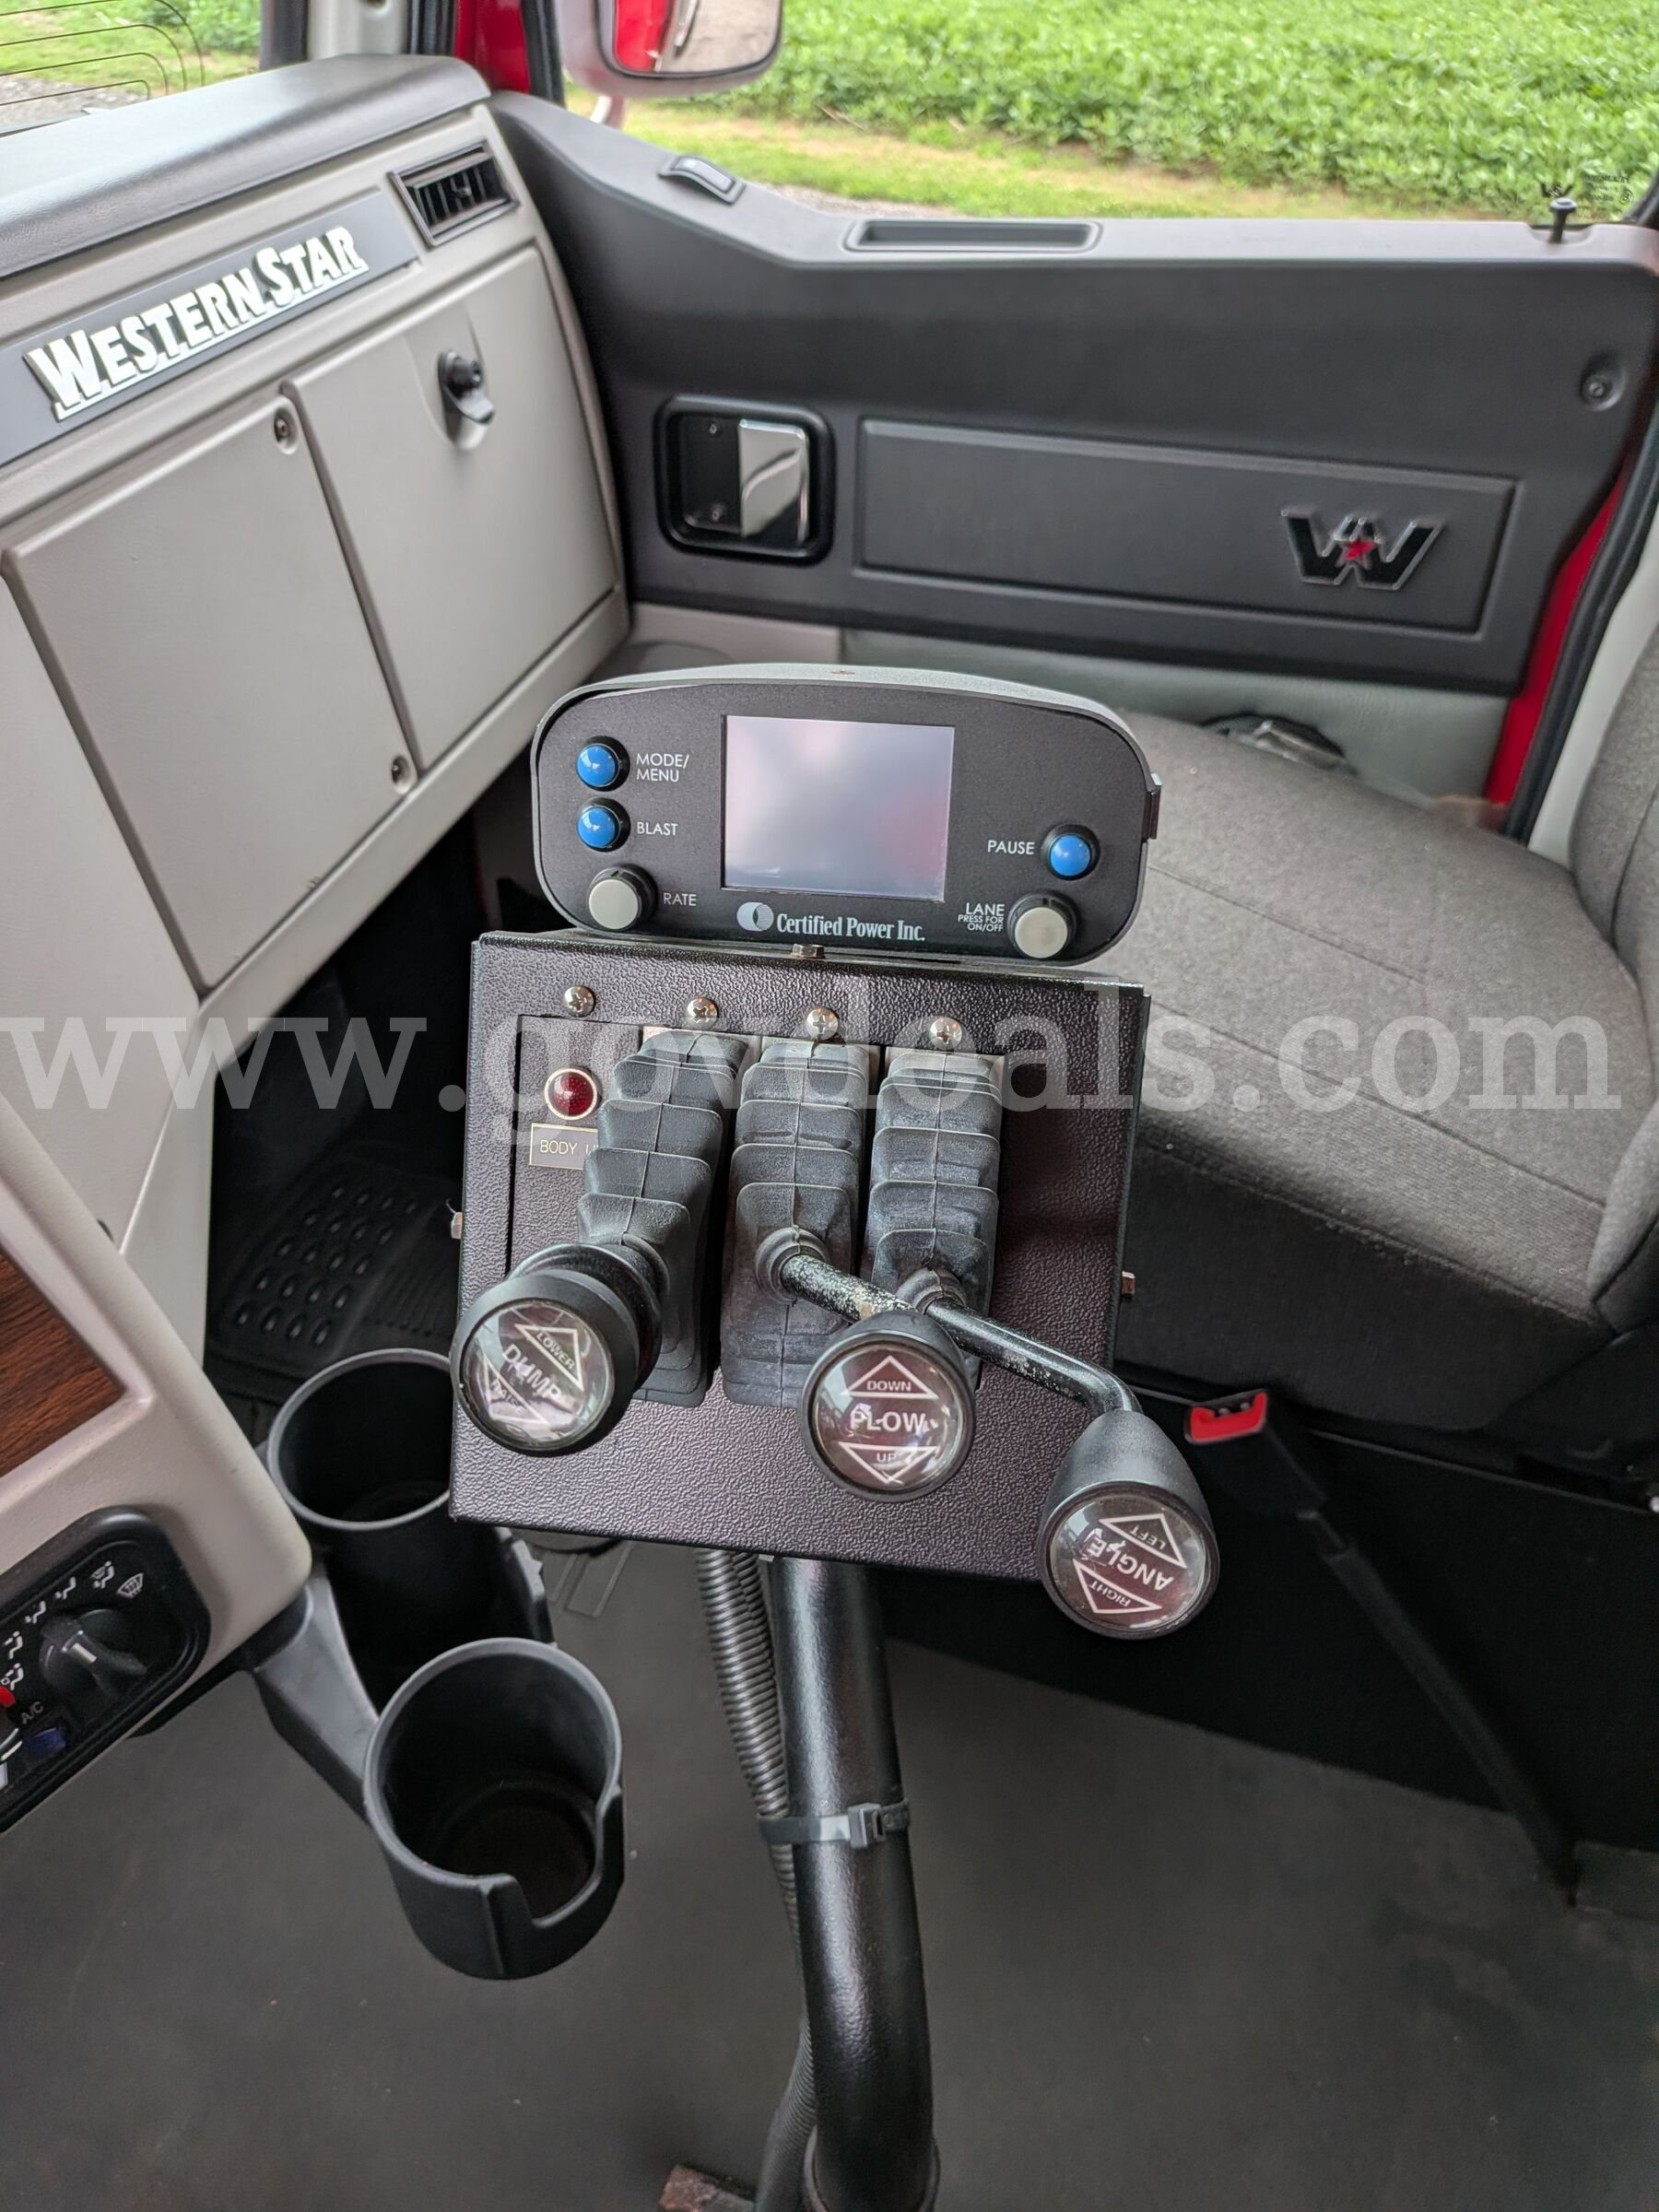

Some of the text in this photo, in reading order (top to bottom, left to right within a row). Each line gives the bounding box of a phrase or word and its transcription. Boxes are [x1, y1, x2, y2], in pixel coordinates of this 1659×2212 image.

[636, 752, 689, 769] MODE/
[636, 768, 679, 782] MENU
[636, 821, 678, 836] BLAST
[987, 840, 1035, 855] PAUSE
[663, 892, 698, 906] RATE
[965, 902, 1006, 916] LANE
[776, 912, 925, 941] Certified Power Inc.
[958, 914, 1005, 924] PRESS FOR
[967, 923, 1004, 933] ON/OFF
[539, 1139, 578, 1156] BODY
[535, 1330, 576, 1371] LOWER
[501, 1342, 564, 1402] DUMP
[866, 1380, 912, 1393] DOWN
[490, 1379, 526, 1416] RAISE
[850, 1410, 927, 1432] PLOW
[877, 1452, 898, 1463] UP
[1129, 1525, 1167, 1550] LEFT
[1086, 1535, 1175, 1592] ANGLE
[1088, 1579, 1132, 1607] RIGHT
[21, 1700, 44, 1724] A/C
